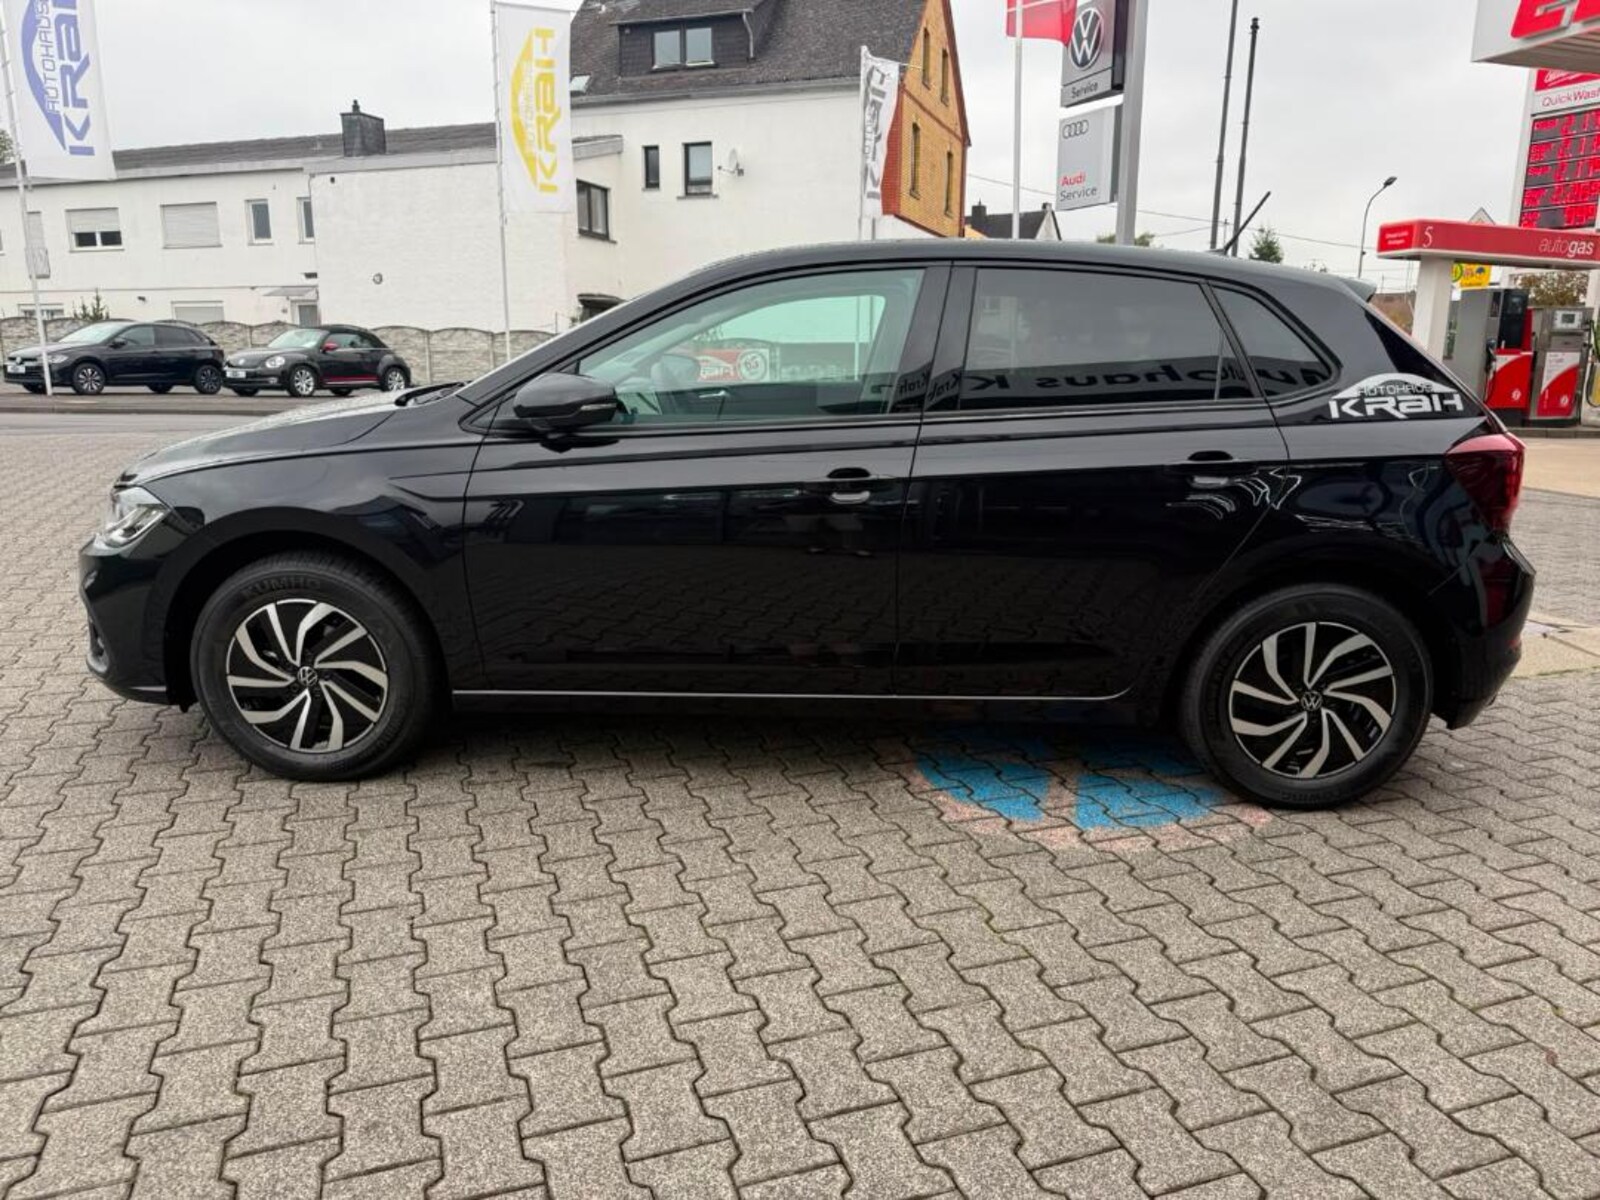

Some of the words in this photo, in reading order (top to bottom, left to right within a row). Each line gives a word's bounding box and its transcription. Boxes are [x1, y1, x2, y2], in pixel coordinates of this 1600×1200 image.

[1071, 81, 1099, 99] Service
[1061, 172, 1086, 187] Audi
[1060, 187, 1098, 202] Service
[1423, 226, 1434, 249] 5
[1539, 236, 1595, 258] autogas
[1358, 383, 1434, 397] AUTOHAUS
